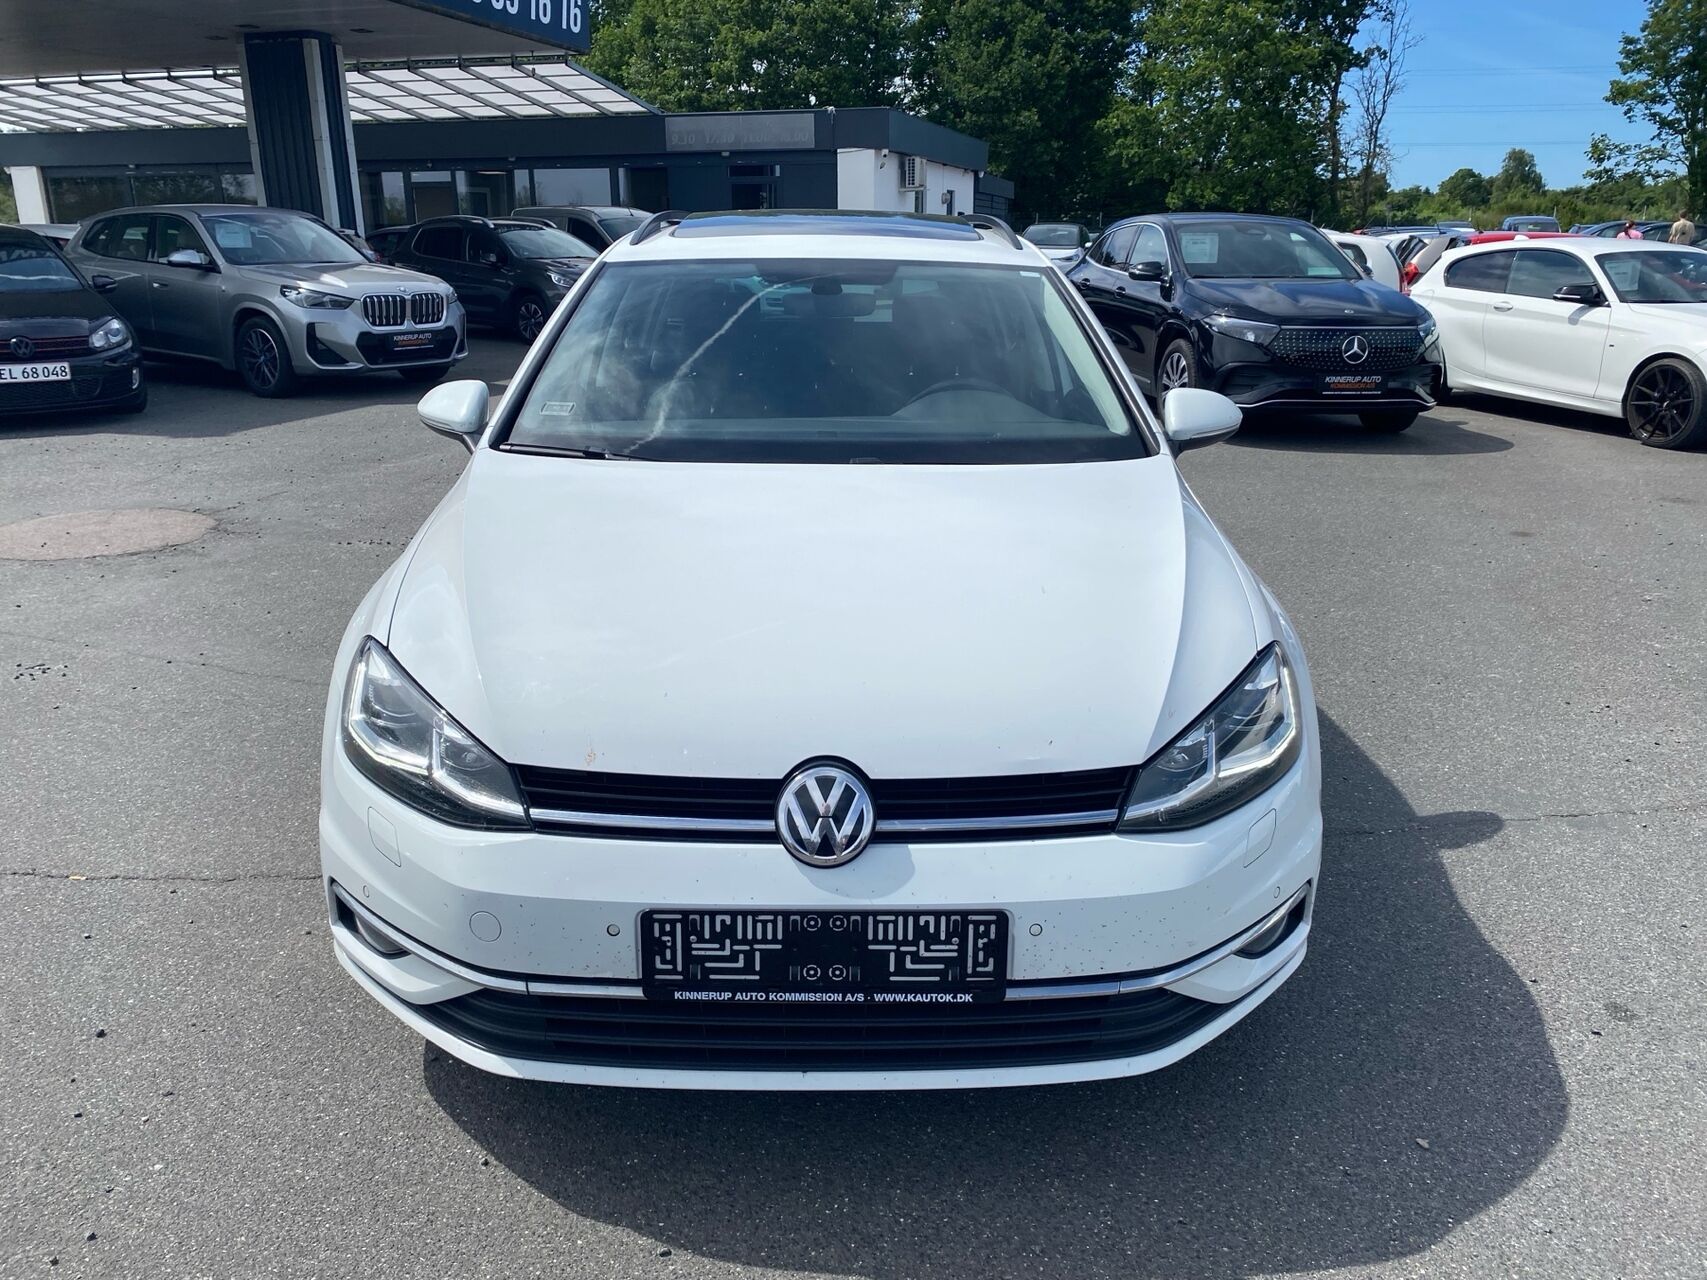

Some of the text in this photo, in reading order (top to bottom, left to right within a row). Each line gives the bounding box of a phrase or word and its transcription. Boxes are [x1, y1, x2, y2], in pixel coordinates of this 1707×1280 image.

[561, 0, 581, 34] 16
[22, 366, 39, 379] 68
[42, 365, 68, 378] 048
[1361, 375, 1382, 383] AUTO
[674, 991, 974, 1003] KINNERUP AUTO KOMMISSION A/S WWW.KAUTOK.DK
